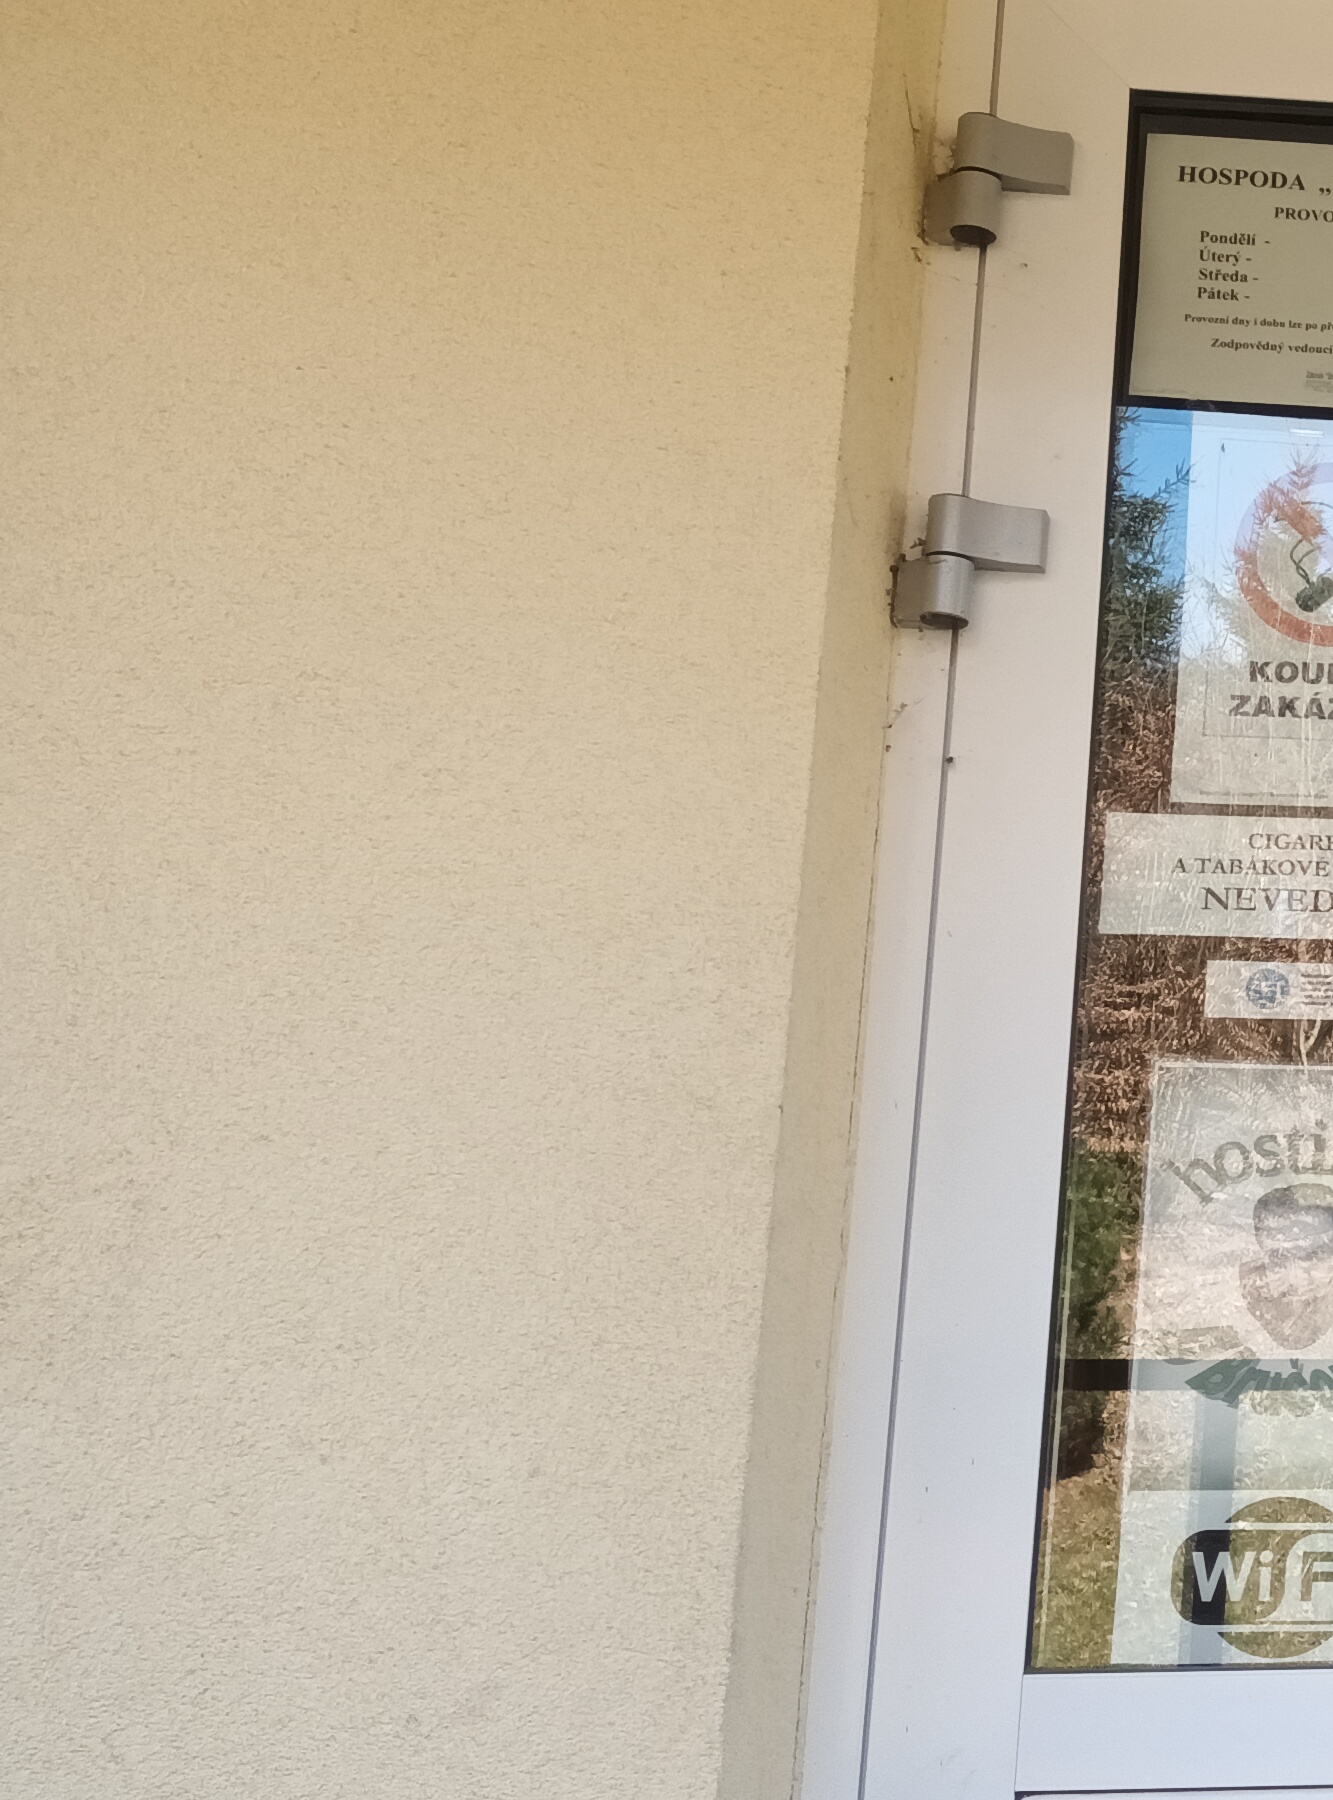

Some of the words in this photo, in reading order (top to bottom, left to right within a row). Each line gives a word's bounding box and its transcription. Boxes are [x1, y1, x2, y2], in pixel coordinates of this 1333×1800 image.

[1177, 165, 1306, 191] HOSPODA
[1200, 230, 1256, 246] Pondělí
[1199, 245, 1241, 267] Úterý
[1198, 267, 1248, 283] Středa
[1197, 286, 1240, 302] Pátek
[1184, 313, 1230, 326] Provozní
[1231, 316, 1250, 327] dny
[1260, 318, 1286, 328] dobu
[1288, 319, 1303, 329] lze
[1305, 322, 1318, 332] po
[1210, 338, 1285, 354] Zodpovědný
[1287, 343, 1333, 355] vedoucí
[1171, 857, 1187, 875] A
[1194, 855, 1330, 877] TABÁKOVÉ
